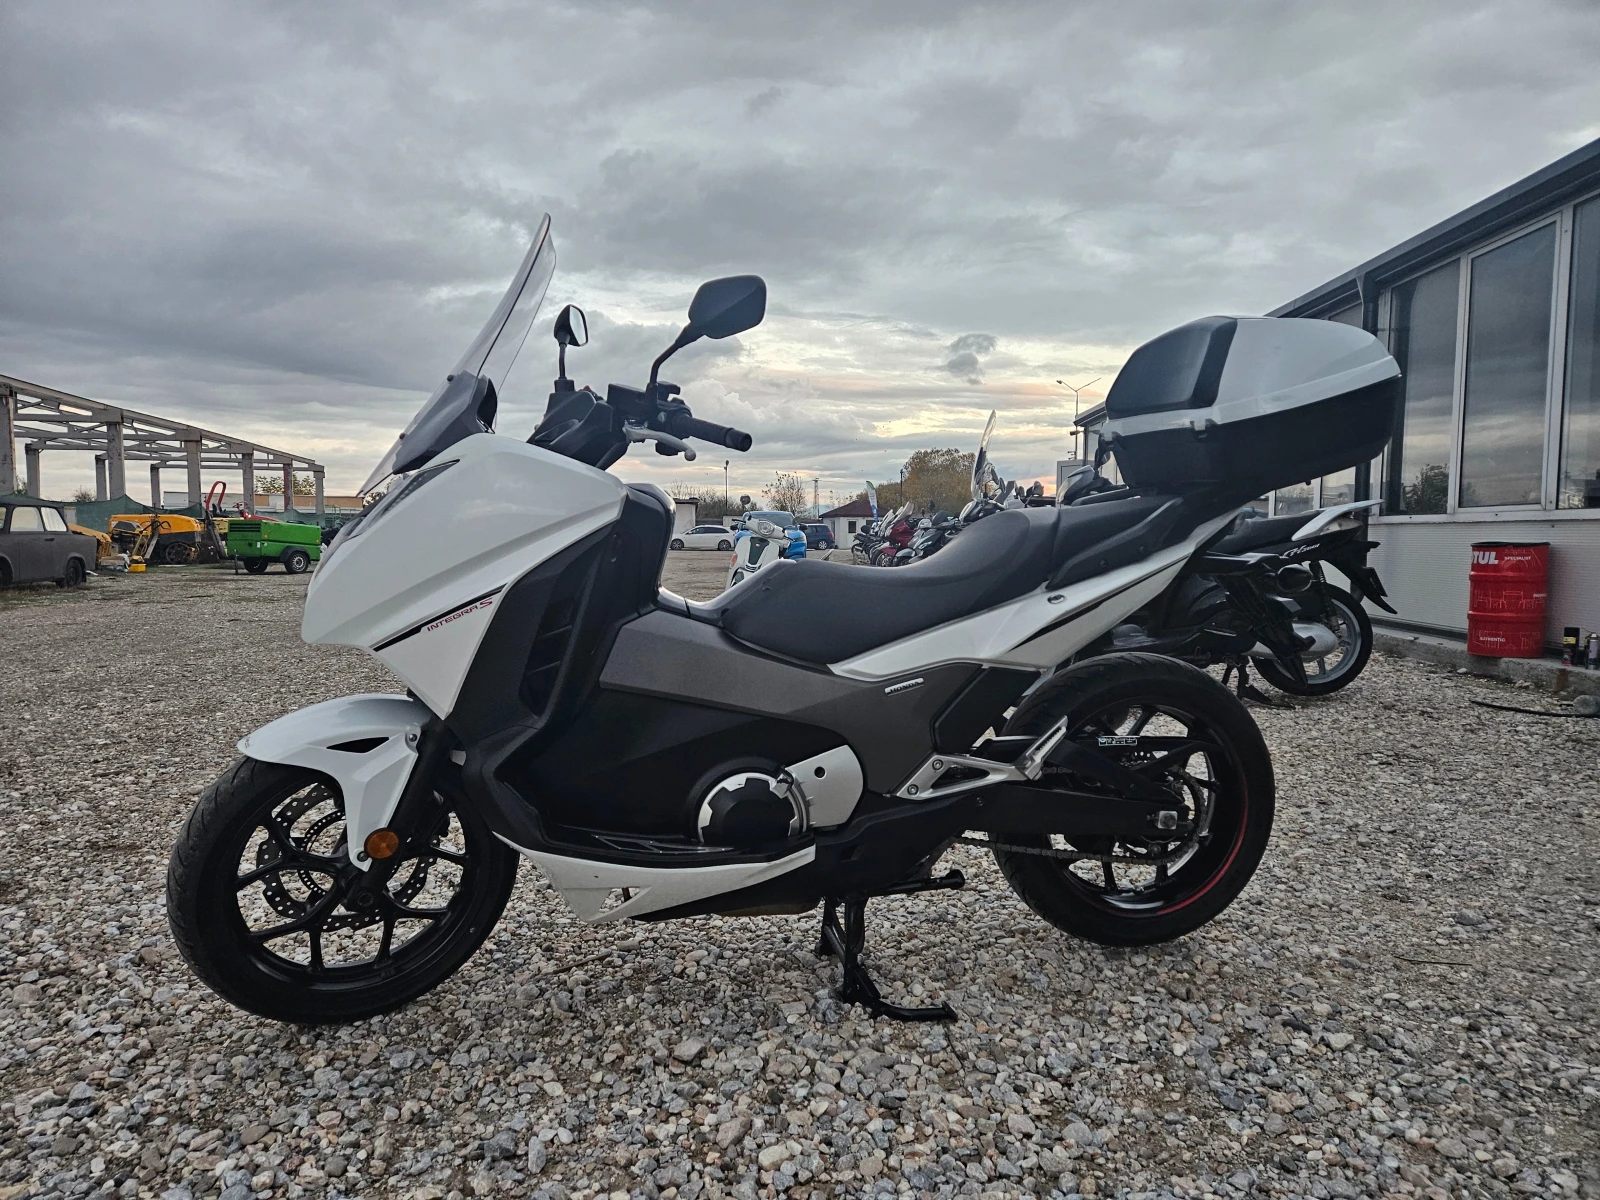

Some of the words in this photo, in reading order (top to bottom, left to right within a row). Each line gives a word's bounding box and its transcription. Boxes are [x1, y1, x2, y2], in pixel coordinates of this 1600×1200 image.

[1471, 551, 1499, 564] TUL
[426, 604, 479, 632] INTEGRA
[479, 597, 493, 610] S
[889, 681, 921, 693] HONDA
